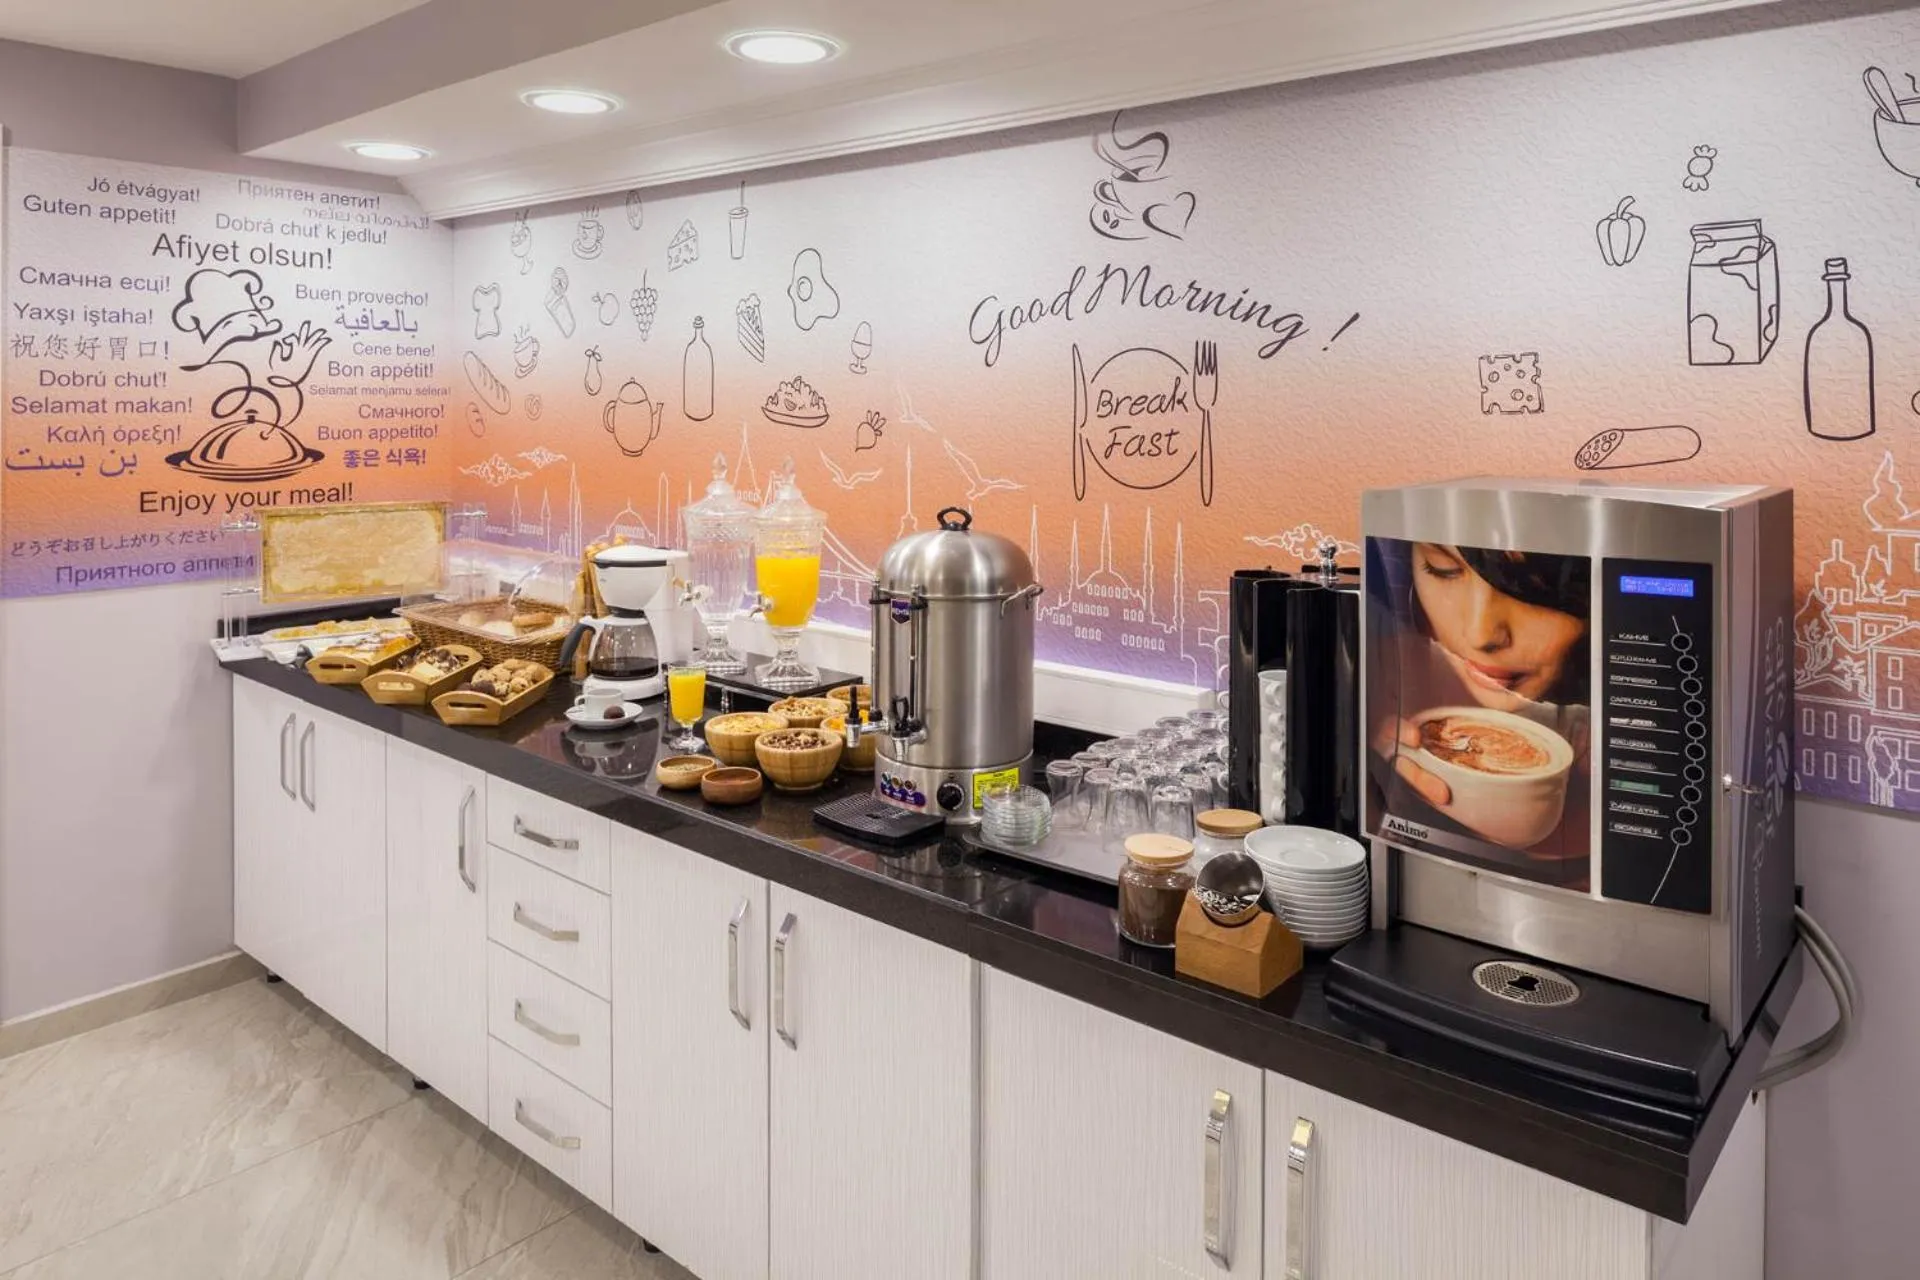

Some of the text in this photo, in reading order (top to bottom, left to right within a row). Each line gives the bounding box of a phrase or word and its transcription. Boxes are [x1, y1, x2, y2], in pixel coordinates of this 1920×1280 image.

[87, 177, 200, 204] Jó étvágyat!
[238, 178, 380, 210] Приятен апетит!
[23, 194, 176, 225] Guten appetit!
[216, 213, 274, 234] Dobrá
[326, 224, 336, 240] k
[341, 226, 387, 245] jedlu!
[152, 233, 333, 269] Afiyet olsun!
[19, 266, 171, 294] Смачна есці!
[295, 283, 429, 306] Buen provecho!
[13, 302, 153, 327] Yaxşı iştaha!
[335, 304, 418, 338] بالعافية
[969, 266, 1087, 368] Good
[353, 342, 435, 357] Cene bene!
[39, 369, 106, 387] Dobrú
[328, 360, 434, 382] Bon appétit!
[309, 384, 357, 396] Selamat
[361, 386, 413, 398] menjamu
[1096, 376, 1189, 418] Break
[11, 396, 193, 415] Selamat makan!
[358, 404, 445, 419] Смачного!
[47, 424, 181, 446] Καλή όρεξη!
[318, 424, 438, 442] Buon appetito!
[1104, 425, 1180, 459] Fast
[99, 449, 138, 477] بن
[343, 448, 427, 469] 좋은 식욕!
[140, 482, 353, 516] Enjoy your meal!
[56, 559, 176, 587] Приятного
[1388, 819, 1428, 839] Animo
